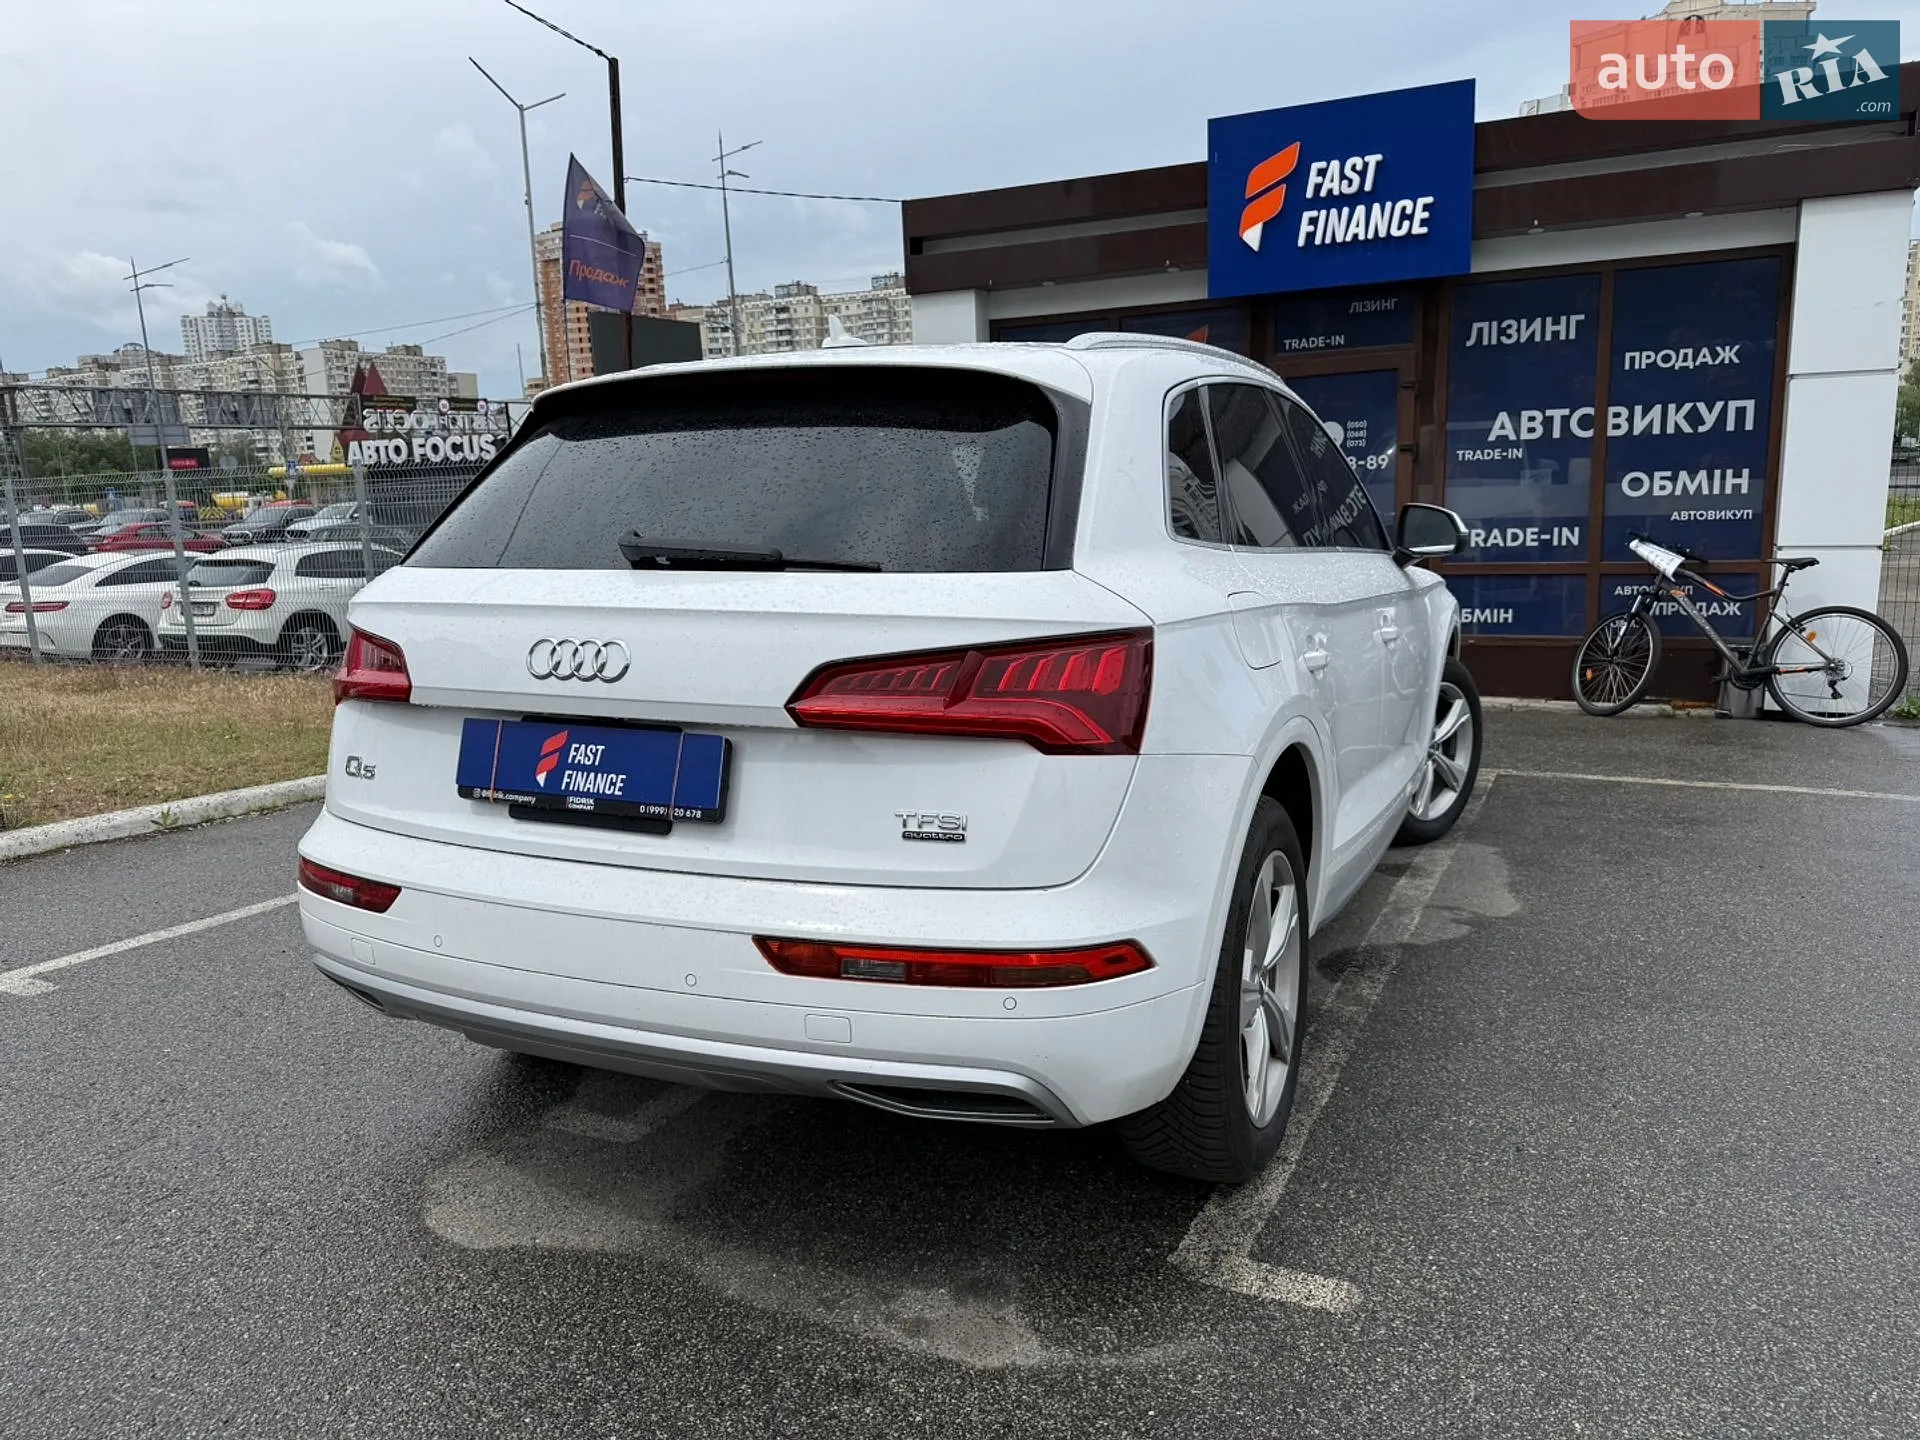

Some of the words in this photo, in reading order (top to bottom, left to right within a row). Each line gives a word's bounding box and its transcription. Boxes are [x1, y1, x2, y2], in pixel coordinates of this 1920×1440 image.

[1305, 153, 1383, 200] FAST
[1297, 196, 1434, 247] FINANCE
[568, 259, 629, 288] Продаж
[1349, 298, 1398, 314] ЛІЗИНГ
[1466, 314, 1585, 347] ЛІЗИНГ
[1283, 334, 1345, 350] TRADE-IN
[1624, 344, 1740, 370] ПРОДАЖ
[347, 438, 408, 466] АВТО
[412, 433, 497, 463] FOCUS
[1456, 447, 1523, 461] TRADE-IN
[1621, 468, 1750, 497] ОБМІН
[1670, 509, 1753, 521] АВТОВИКУП
[1470, 526, 1580, 547] RADE-IN
[1460, 608, 1513, 624] БМІН
[567, 744, 605, 766] FAST
[346, 755, 376, 780] Q5
[561, 770, 626, 795] FINANCE
[685, 809, 702, 819] 678
[894, 810, 968, 831] TFSI
[904, 832, 964, 841] quattro
